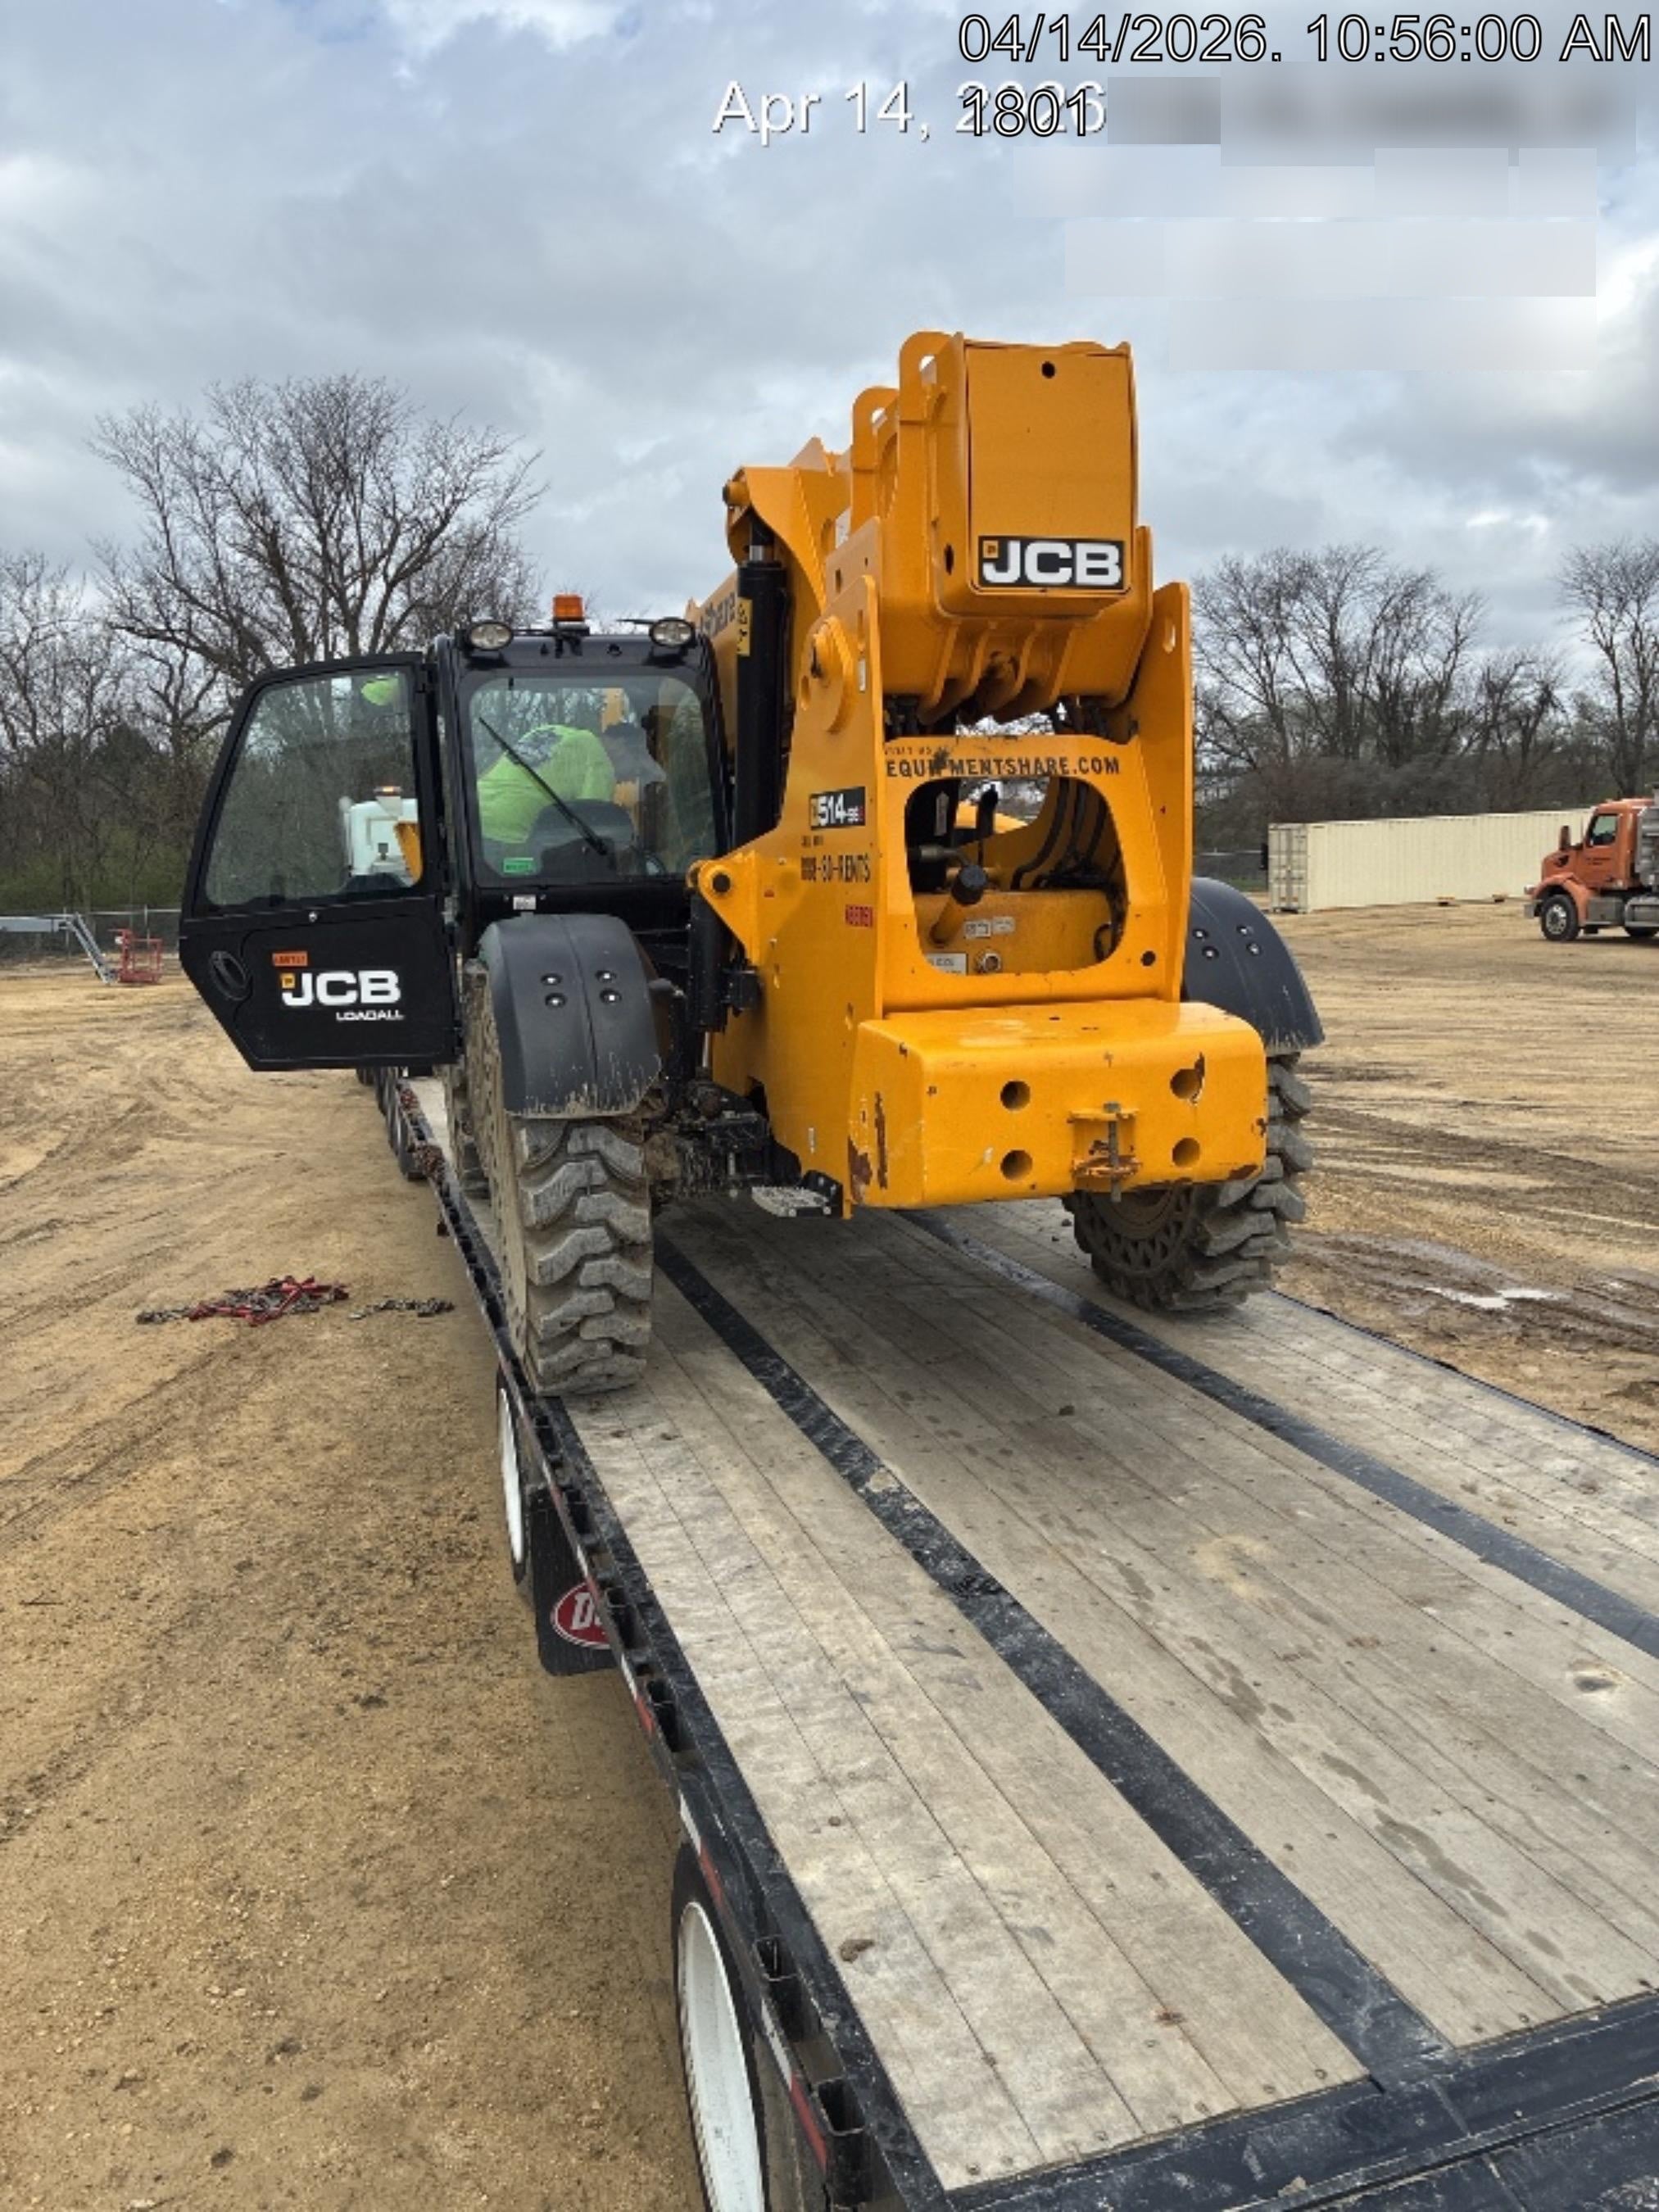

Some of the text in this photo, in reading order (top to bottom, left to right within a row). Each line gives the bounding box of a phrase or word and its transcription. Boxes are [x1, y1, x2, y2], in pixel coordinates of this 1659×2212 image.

[982, 539, 1122, 587] JCB
[886, 756, 1121, 779] EQUIMENTSHARE.COM
[281, 970, 402, 1007] JCB
[336, 1009, 405, 1022] LOADALL
